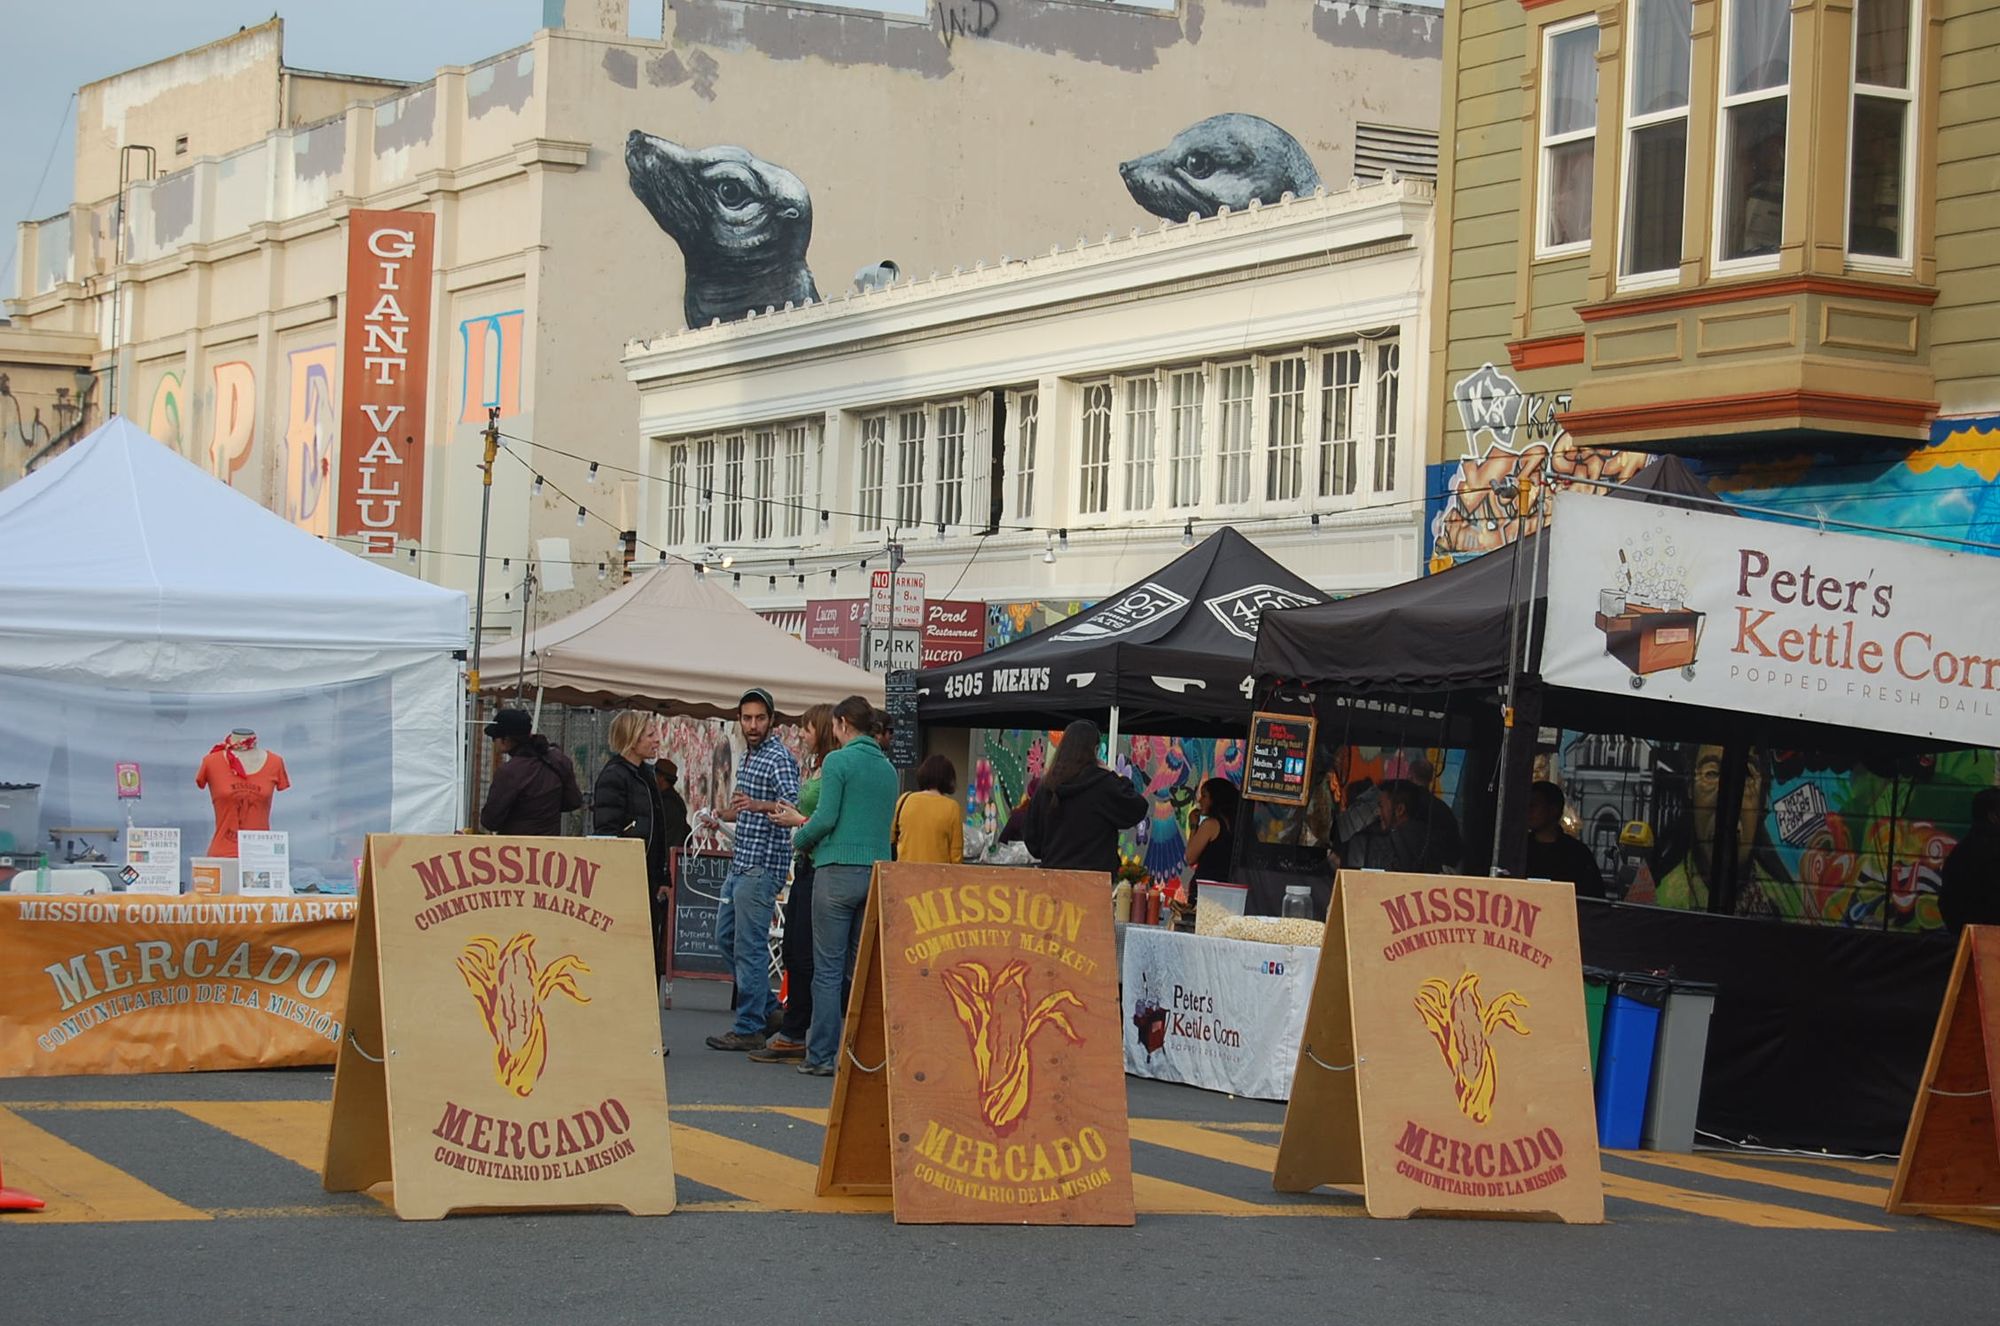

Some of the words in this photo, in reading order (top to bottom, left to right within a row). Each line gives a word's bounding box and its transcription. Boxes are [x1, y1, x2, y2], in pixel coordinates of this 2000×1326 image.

[362, 228, 416, 385] GIANT
[355, 404, 406, 559] VALUE
[874, 572, 889, 588] NO
[896, 577, 924, 589] ARKING
[1737, 549, 1893, 618] Peter's
[926, 625, 979, 638] Restaurant
[928, 604, 968, 623] Perol
[874, 639, 915, 653] PARK
[920, 645, 963, 662] ucero
[1731, 606, 1884, 674] Kettle
[944, 672, 984, 699] 4505
[991, 667, 1051, 693] MEATS
[1730, 665, 1828, 692] POPPED
[1846, 682, 1921, 705] FRESH
[411, 845, 602, 900] MISSION
[19, 902, 120, 923] MISSION
[125, 902, 266, 925] COMMUNITY
[414, 890, 526, 931] COMMUNITY
[532, 891, 615, 933] MARKET
[905, 884, 1088, 943] MISSION
[1380, 888, 1542, 938] MISSION
[904, 929, 1012, 965] COMMUNITY
[1019, 933, 1098, 977] MARKET
[1383, 928, 1477, 962] COMMUNITY
[1483, 930, 1553, 969] MARKET
[44, 939, 338, 1011] MERCADO
[37, 984, 191, 1052] COMUNITARIO
[197, 984, 226, 1003] DE
[232, 984, 260, 1011] LA
[1173, 985, 1213, 1014] Peter's
[1171, 1012, 1211, 1042] Kettle
[1213, 1019, 1240, 1048] Corn
[432, 1098, 632, 1160] MERCADO
[1395, 1120, 1566, 1178] MERCADO
[434, 1146, 540, 1181] COMUNITARIO
[542, 1164, 562, 1181] DE
[564, 1160, 585, 1178] LA
[587, 1138, 636, 1173] MISIÓN
[914, 1120, 1108, 1183] MERCADO
[913, 1163, 1015, 1204] COMUNITARIO
[1018, 1188, 1038, 1204] DE
[1039, 1185, 1059, 1202] LA
[1396, 1160, 1487, 1197] COMUNITARIO
[1487, 1182, 1505, 1197] DE
[1507, 1181, 1524, 1196] LA
